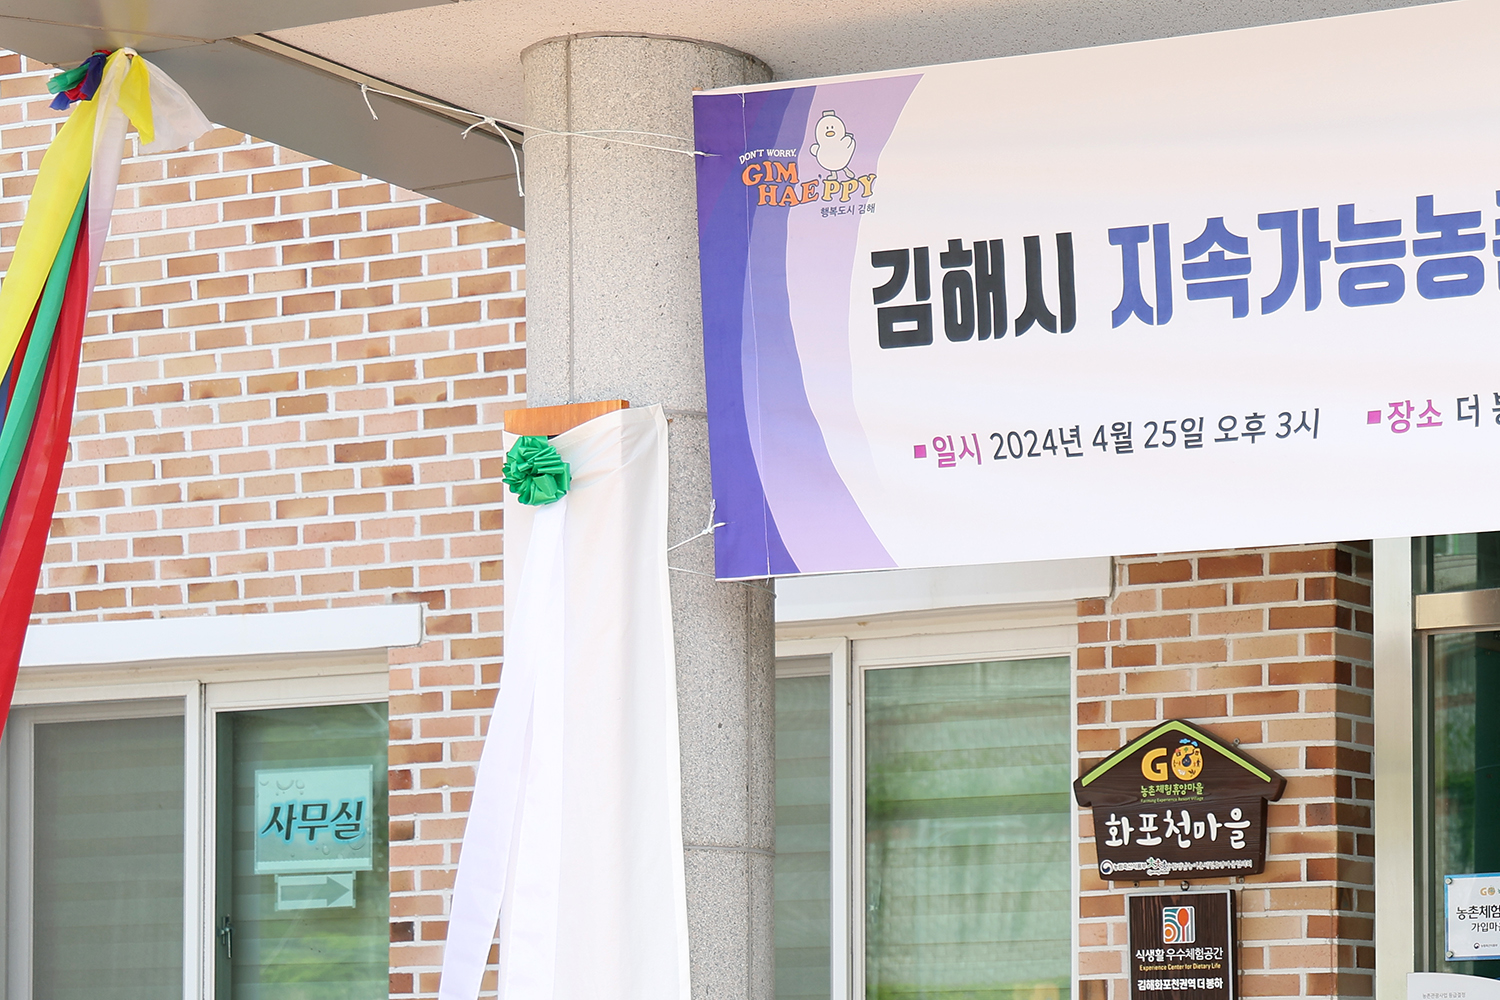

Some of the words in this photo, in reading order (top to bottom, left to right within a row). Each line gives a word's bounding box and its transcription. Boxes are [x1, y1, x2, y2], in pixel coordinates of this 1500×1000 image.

[739, 149, 764, 164] DON'T
[742, 160, 799, 186] GIM
[821, 206, 855, 218] 행복도시
[858, 203, 876, 215] 김해
[870, 232, 1077, 349] 김해시
[1387, 400, 1443, 434] 장소
[1456, 394, 1480, 428] 더
[931, 433, 983, 468] 일시
[989, 428, 1084, 461] 2024년
[1092, 422, 1135, 456] 4월
[1144, 416, 1204, 450] 25일
[1214, 412, 1267, 445] 오후
[1276, 408, 1321, 441] 3시
[1141, 782, 1204, 798] 농촌체험휴양마을
[261, 801, 363, 840] 사무실
[1105, 808, 1251, 849] 화포천마을
[1456, 904, 1500, 920] 농촌체험
[1136, 949, 1164, 962] 식생활
[1166, 947, 1223, 961] 우수체험공간
[1140, 964, 1166, 972] Experience
[1193, 963, 1211, 971] Dietary
[1138, 978, 1196, 991] 김해화포천권역
[1206, 977, 1223, 989] 봉하
